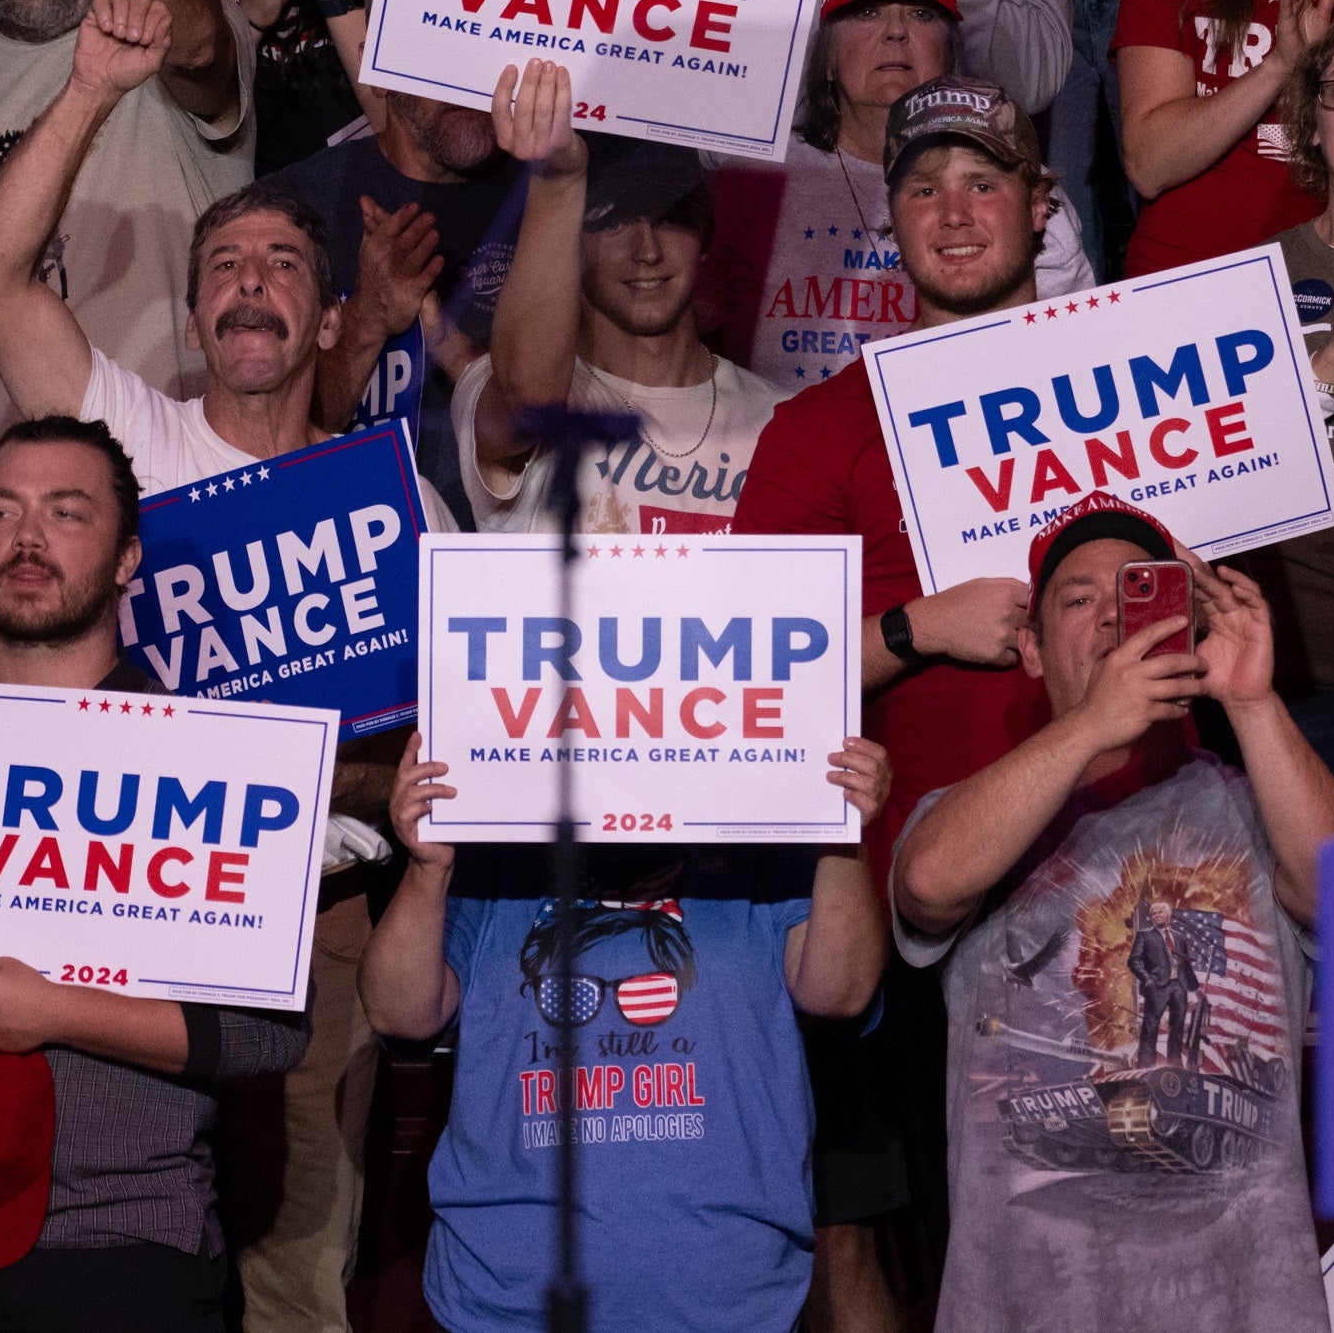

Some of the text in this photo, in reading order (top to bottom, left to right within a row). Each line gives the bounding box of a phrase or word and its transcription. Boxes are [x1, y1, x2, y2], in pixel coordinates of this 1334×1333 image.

[906, 90, 991, 119] Trump
[908, 328, 1275, 469] TRUMP
[965, 402, 1255, 514] VANCE
[449, 617, 829, 682] TRUMP
[491, 687, 784, 739] VANCE
[470, 747, 805, 764] MAKE AMERICA GREAT AGAIN!
[602, 814, 672, 831] 2024
[61, 964, 128, 986] 2024
[598, 1031, 659, 1057] still
[672, 1036, 695, 1055] a
[519, 1062, 705, 1117] TRMP GIRL
[1011, 1087, 1096, 1112] TRUMP
[1202, 1080, 1259, 1129] TRUMP
[531, 1113, 704, 1148] MAE NO APOLOGIES
